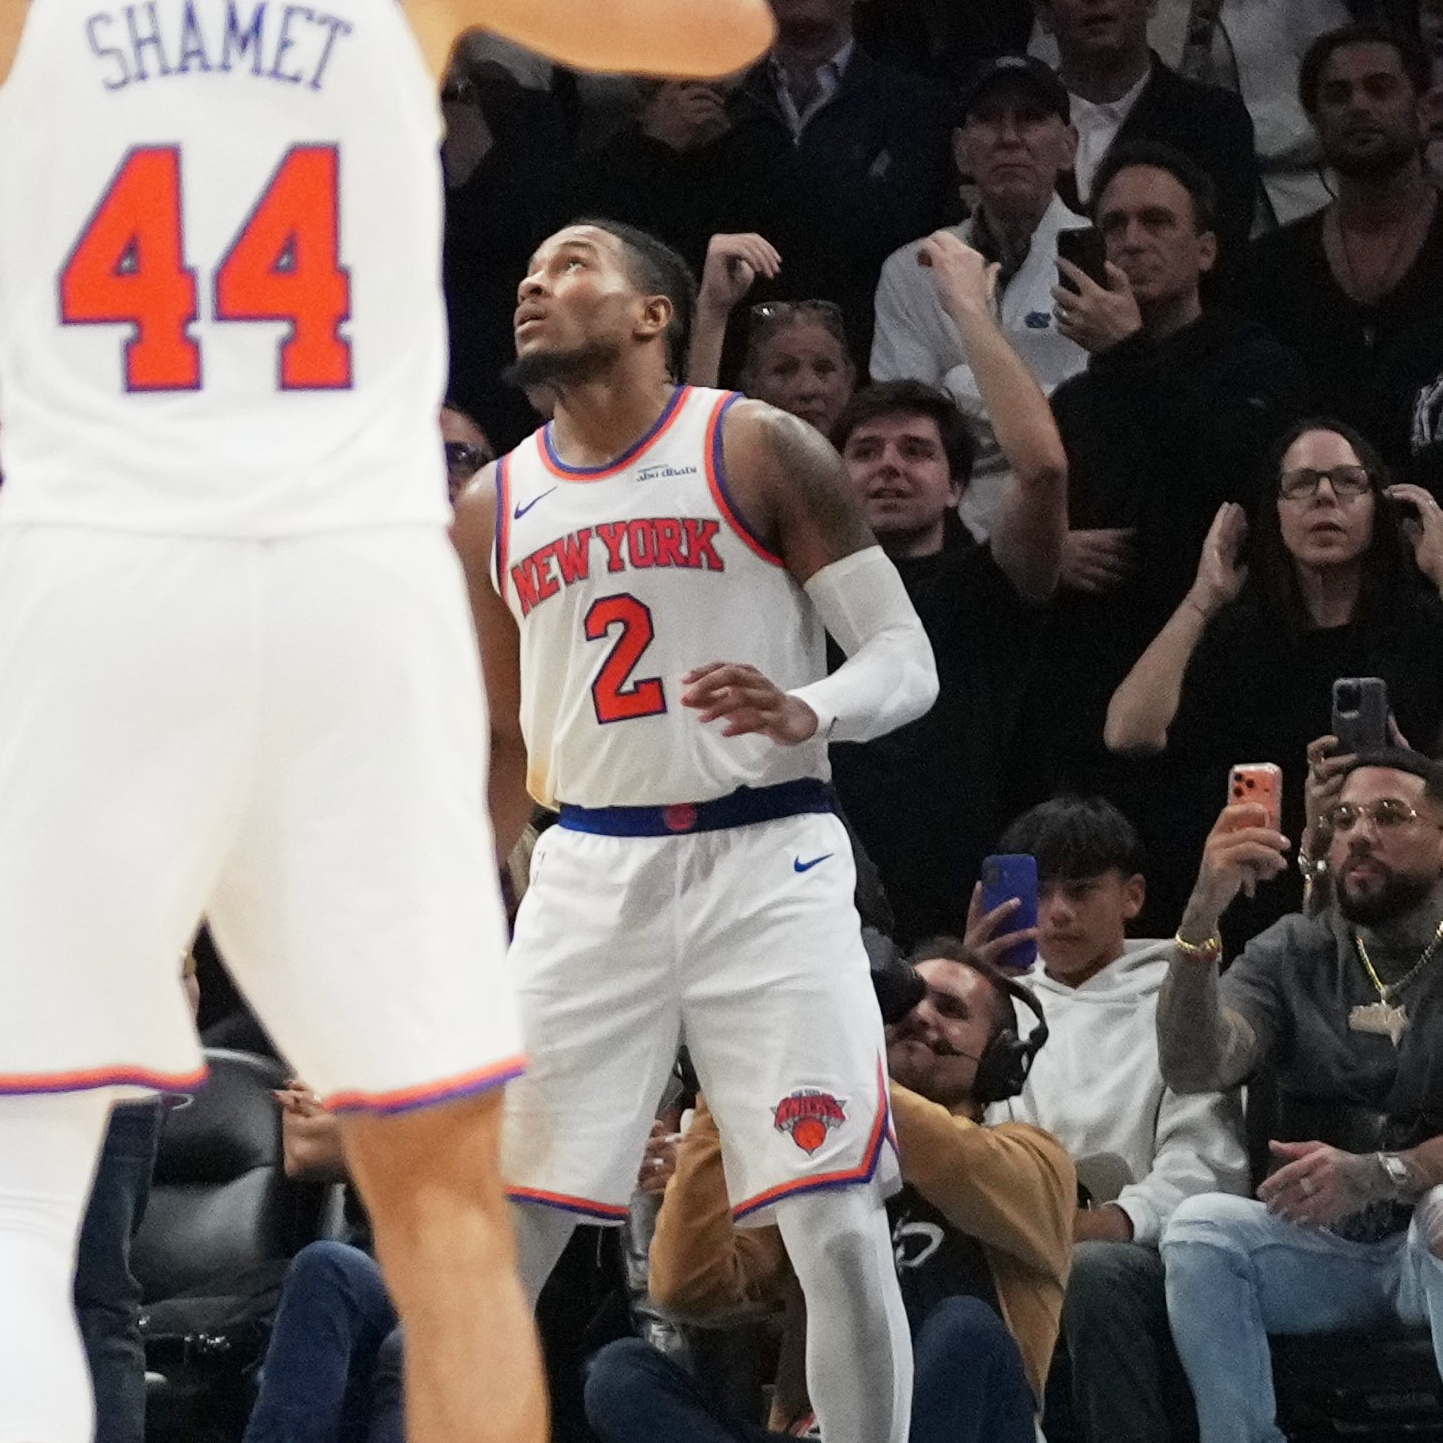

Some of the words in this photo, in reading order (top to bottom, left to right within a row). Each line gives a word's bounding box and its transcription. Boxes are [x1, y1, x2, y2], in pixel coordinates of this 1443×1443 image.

[57, 140, 354, 392] 44
[511, 527, 592, 620] NEW
[595, 517, 725, 573] YORK
[583, 591, 669, 725] 2
